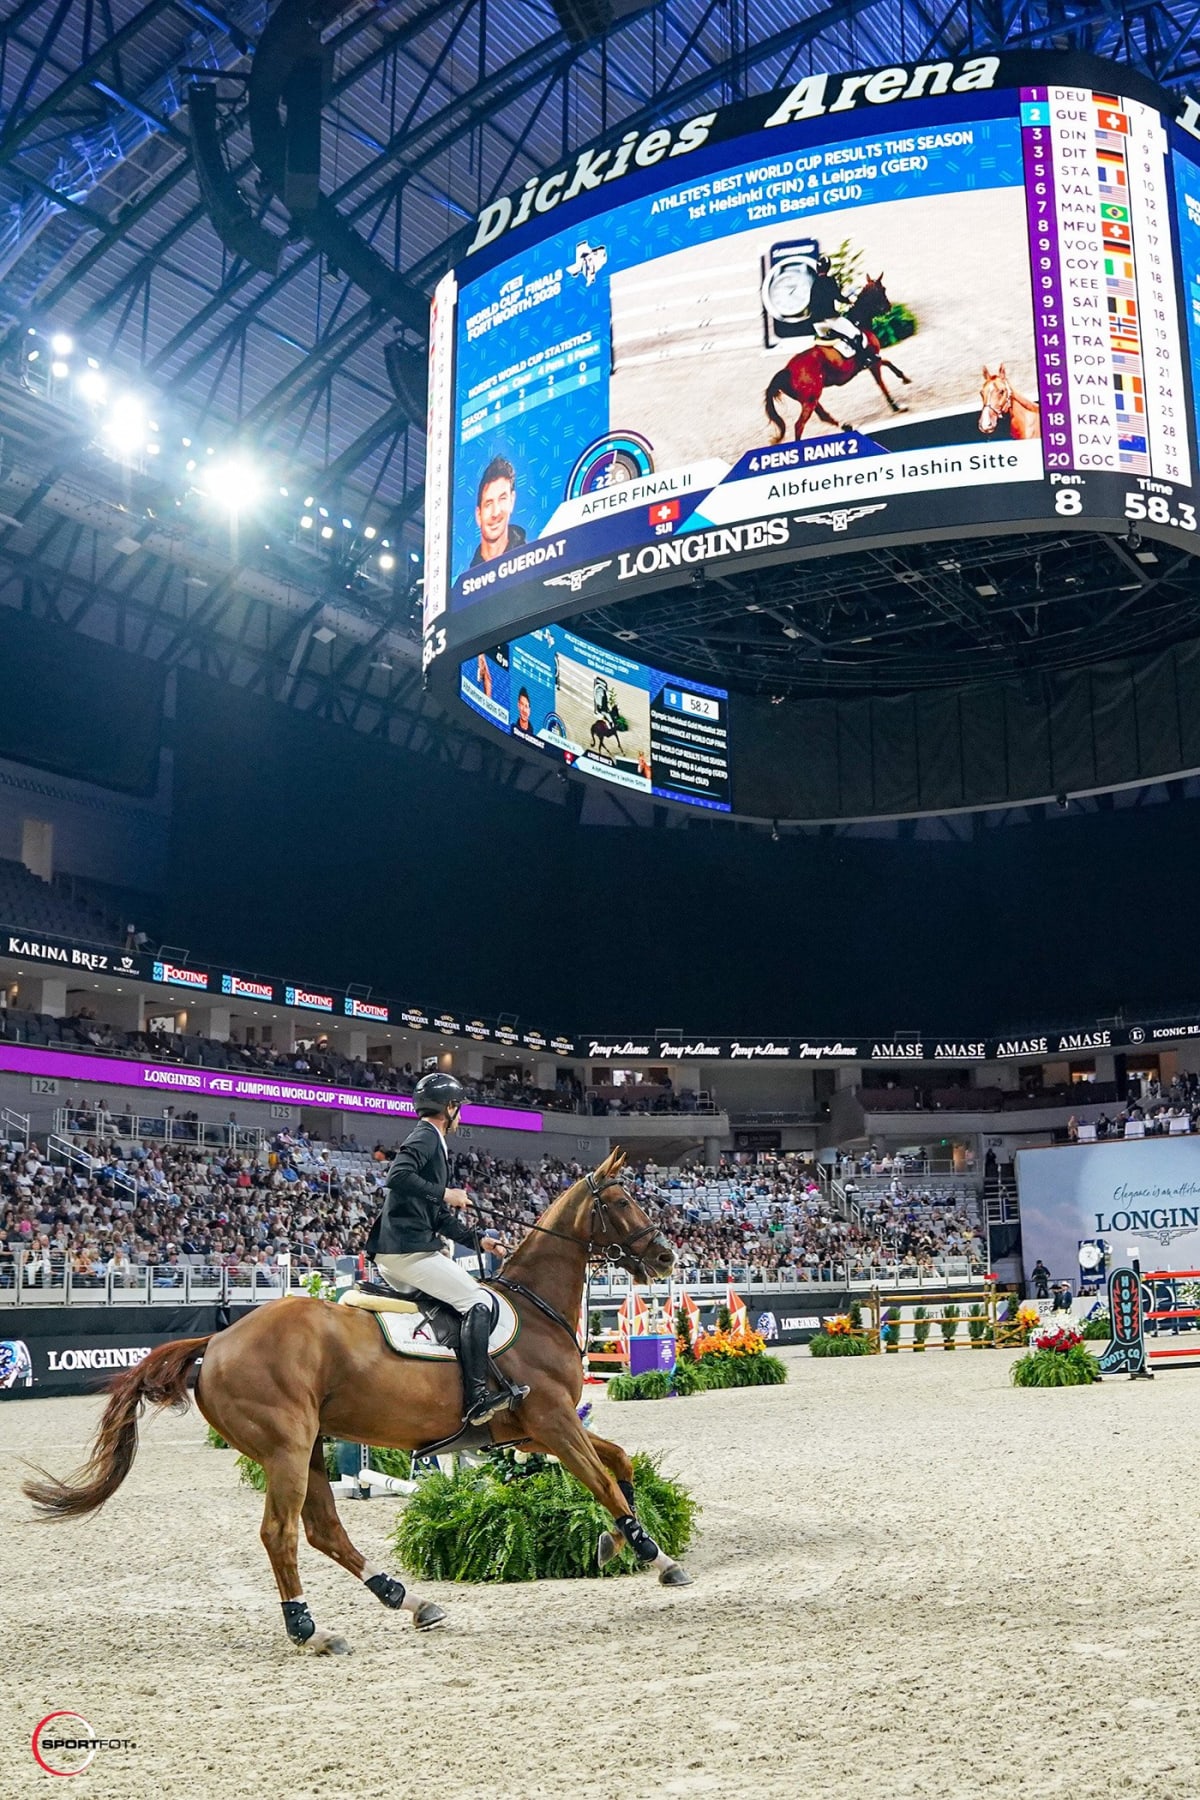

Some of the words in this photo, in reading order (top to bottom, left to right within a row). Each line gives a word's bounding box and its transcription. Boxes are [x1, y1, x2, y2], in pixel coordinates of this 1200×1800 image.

[1031, 89, 1037, 100] 1
[1055, 90, 1085, 102] DEU
[1030, 109, 1040, 121] 2
[1056, 110, 1088, 121] GUE
[1033, 128, 1042, 140] 3
[1060, 130, 1086, 140] DIN
[1143, 145, 1149, 154] 9
[466, 113, 717, 257] Dickies
[764, 55, 1000, 128] Arena
[1033, 146, 1043, 158] 3
[1062, 148, 1086, 158] DIT
[1144, 163, 1150, 172] 9
[651, 184, 711, 215] ATHLETE'S
[713, 173, 742, 194] BEST
[745, 162, 793, 184] WORLD
[795, 155, 822, 171] CUP
[825, 144, 882, 166] RESULTS
[885, 138, 914, 154] THIS
[917, 131, 973, 149] SEASON
[1035, 165, 1044, 176] 5
[1061, 166, 1090, 176] STA
[1143, 180, 1154, 191] 10
[688, 205, 706, 219] 1st
[709, 187, 762, 213] Helsinki
[766, 178, 804, 199] (FIN)
[807, 174, 818, 189] &
[822, 165, 877, 186] Leipzig
[881, 156, 928, 175] (GER)
[1035, 183, 1046, 195] 6
[1062, 184, 1093, 196] VAL
[1144, 198, 1155, 209] 12
[747, 204, 776, 221] 12th
[780, 192, 819, 213] Basel
[823, 185, 862, 205] (SUI)
[1036, 201, 1047, 213] 7
[1061, 203, 1096, 214] MAN
[1146, 216, 1157, 227] 14
[1037, 220, 1049, 232] 8
[1064, 221, 1096, 232] MFU
[1148, 234, 1158, 246] 17
[1039, 238, 1050, 250] 9
[1064, 240, 1098, 251] VOG
[1149, 253, 1160, 264] 18
[1040, 257, 1051, 269] 9
[1066, 259, 1099, 270] COY
[1151, 271, 1162, 284] 18
[466, 302, 499, 330] WORLD
[500, 290, 522, 309] CUP
[525, 269, 563, 297] FINALS
[1041, 276, 1052, 288] 9
[1069, 278, 1099, 289] KEE
[1152, 290, 1164, 302] 18
[468, 318, 492, 342] FORT
[493, 297, 532, 326] WORTH
[533, 282, 561, 306] 2026
[1042, 295, 1054, 308] 9
[1154, 309, 1165, 321] 18
[1041, 315, 1057, 327] 13
[1072, 317, 1102, 327] LYN
[1155, 328, 1167, 340] 19
[1042, 334, 1059, 347] 14
[1072, 335, 1104, 347] TRA
[1156, 347, 1170, 359] 20
[498, 360, 527, 382] WORLD
[528, 352, 544, 367] CUP
[1043, 353, 1061, 366] 15
[1074, 354, 1105, 366] POP
[1159, 367, 1170, 378] 21
[1045, 373, 1062, 385] 16
[1074, 374, 1108, 385] VAN
[1159, 386, 1173, 398] 24
[1046, 393, 1062, 405] 17
[1080, 394, 1105, 405] DIL
[1161, 405, 1174, 417] 25
[1047, 413, 1065, 426] 18
[1077, 414, 1110, 426] KRA
[1162, 425, 1176, 436] 28
[1049, 433, 1066, 446] 19
[1079, 434, 1112, 445] DAV
[749, 457, 759, 471] 4
[761, 449, 799, 470] PENS
[804, 440, 845, 461] RANK
[847, 439, 858, 454] 2
[1048, 453, 1070, 466] 20
[1079, 454, 1114, 466] GOC
[1166, 464, 1179, 476] 36
[596, 470, 625, 489] 22.6
[768, 467, 894, 500] Albfuehren's
[969, 454, 1018, 470] Sitte
[1050, 473, 1086, 485] Pen.
[1137, 478, 1173, 495] Time
[581, 491, 627, 517] AFTER
[632, 478, 678, 500] FINAL
[683, 474, 691, 486] II
[1055, 489, 1083, 516] 8
[1124, 492, 1197, 531] 58.3
[655, 522, 673, 535] SUI
[618, 517, 790, 580] LONGINES
[462, 571, 496, 596] Steve
[498, 539, 566, 578] GUERDAT
[690, 698, 710, 714] 58.2
[8, 937, 68, 962] KARINA
[72, 949, 108, 970] BREZ
[153, 962, 163, 981] ESI
[163, 963, 208, 984] FOOTING
[222, 974, 231, 993] ESI
[231, 977, 272, 996] FOOTING
[285, 987, 294, 1005] ESI
[294, 989, 332, 1007] FOOTING
[353, 1000, 388, 1017] FOOTING
[1153, 1028, 1186, 1038] ICONIC
[589, 1041, 612, 1058] Tony
[620, 1042, 649, 1055] Lama
[660, 1042, 684, 1059] Tony
[691, 1042, 720, 1055] Lama
[731, 1043, 755, 1059] Tony
[762, 1042, 789, 1055] Lama
[800, 1043, 823, 1059] Tony
[830, 1043, 857, 1055] Lama
[36, 1080, 56, 1093] 124
[144, 1070, 200, 1087] LONGINES
[235, 1081, 280, 1097] JUMPING
[281, 1087, 315, 1100] WORLD
[316, 1091, 335, 1103] CUP
[338, 1094, 363, 1107] FINAL
[364, 1097, 385, 1109] FORT
[274, 1106, 290, 1118] 125
[1113, 1183, 1150, 1210] Elegance
[1152, 1185, 1160, 1197] is
[1095, 1207, 1199, 1232] LONGIN
[1121, 1275, 1131, 1340] HOWDY
[781, 1317, 820, 1330] LONGINES
[48, 1348, 152, 1370] LONGINES
[1101, 1349, 1126, 1370] BOOTS
